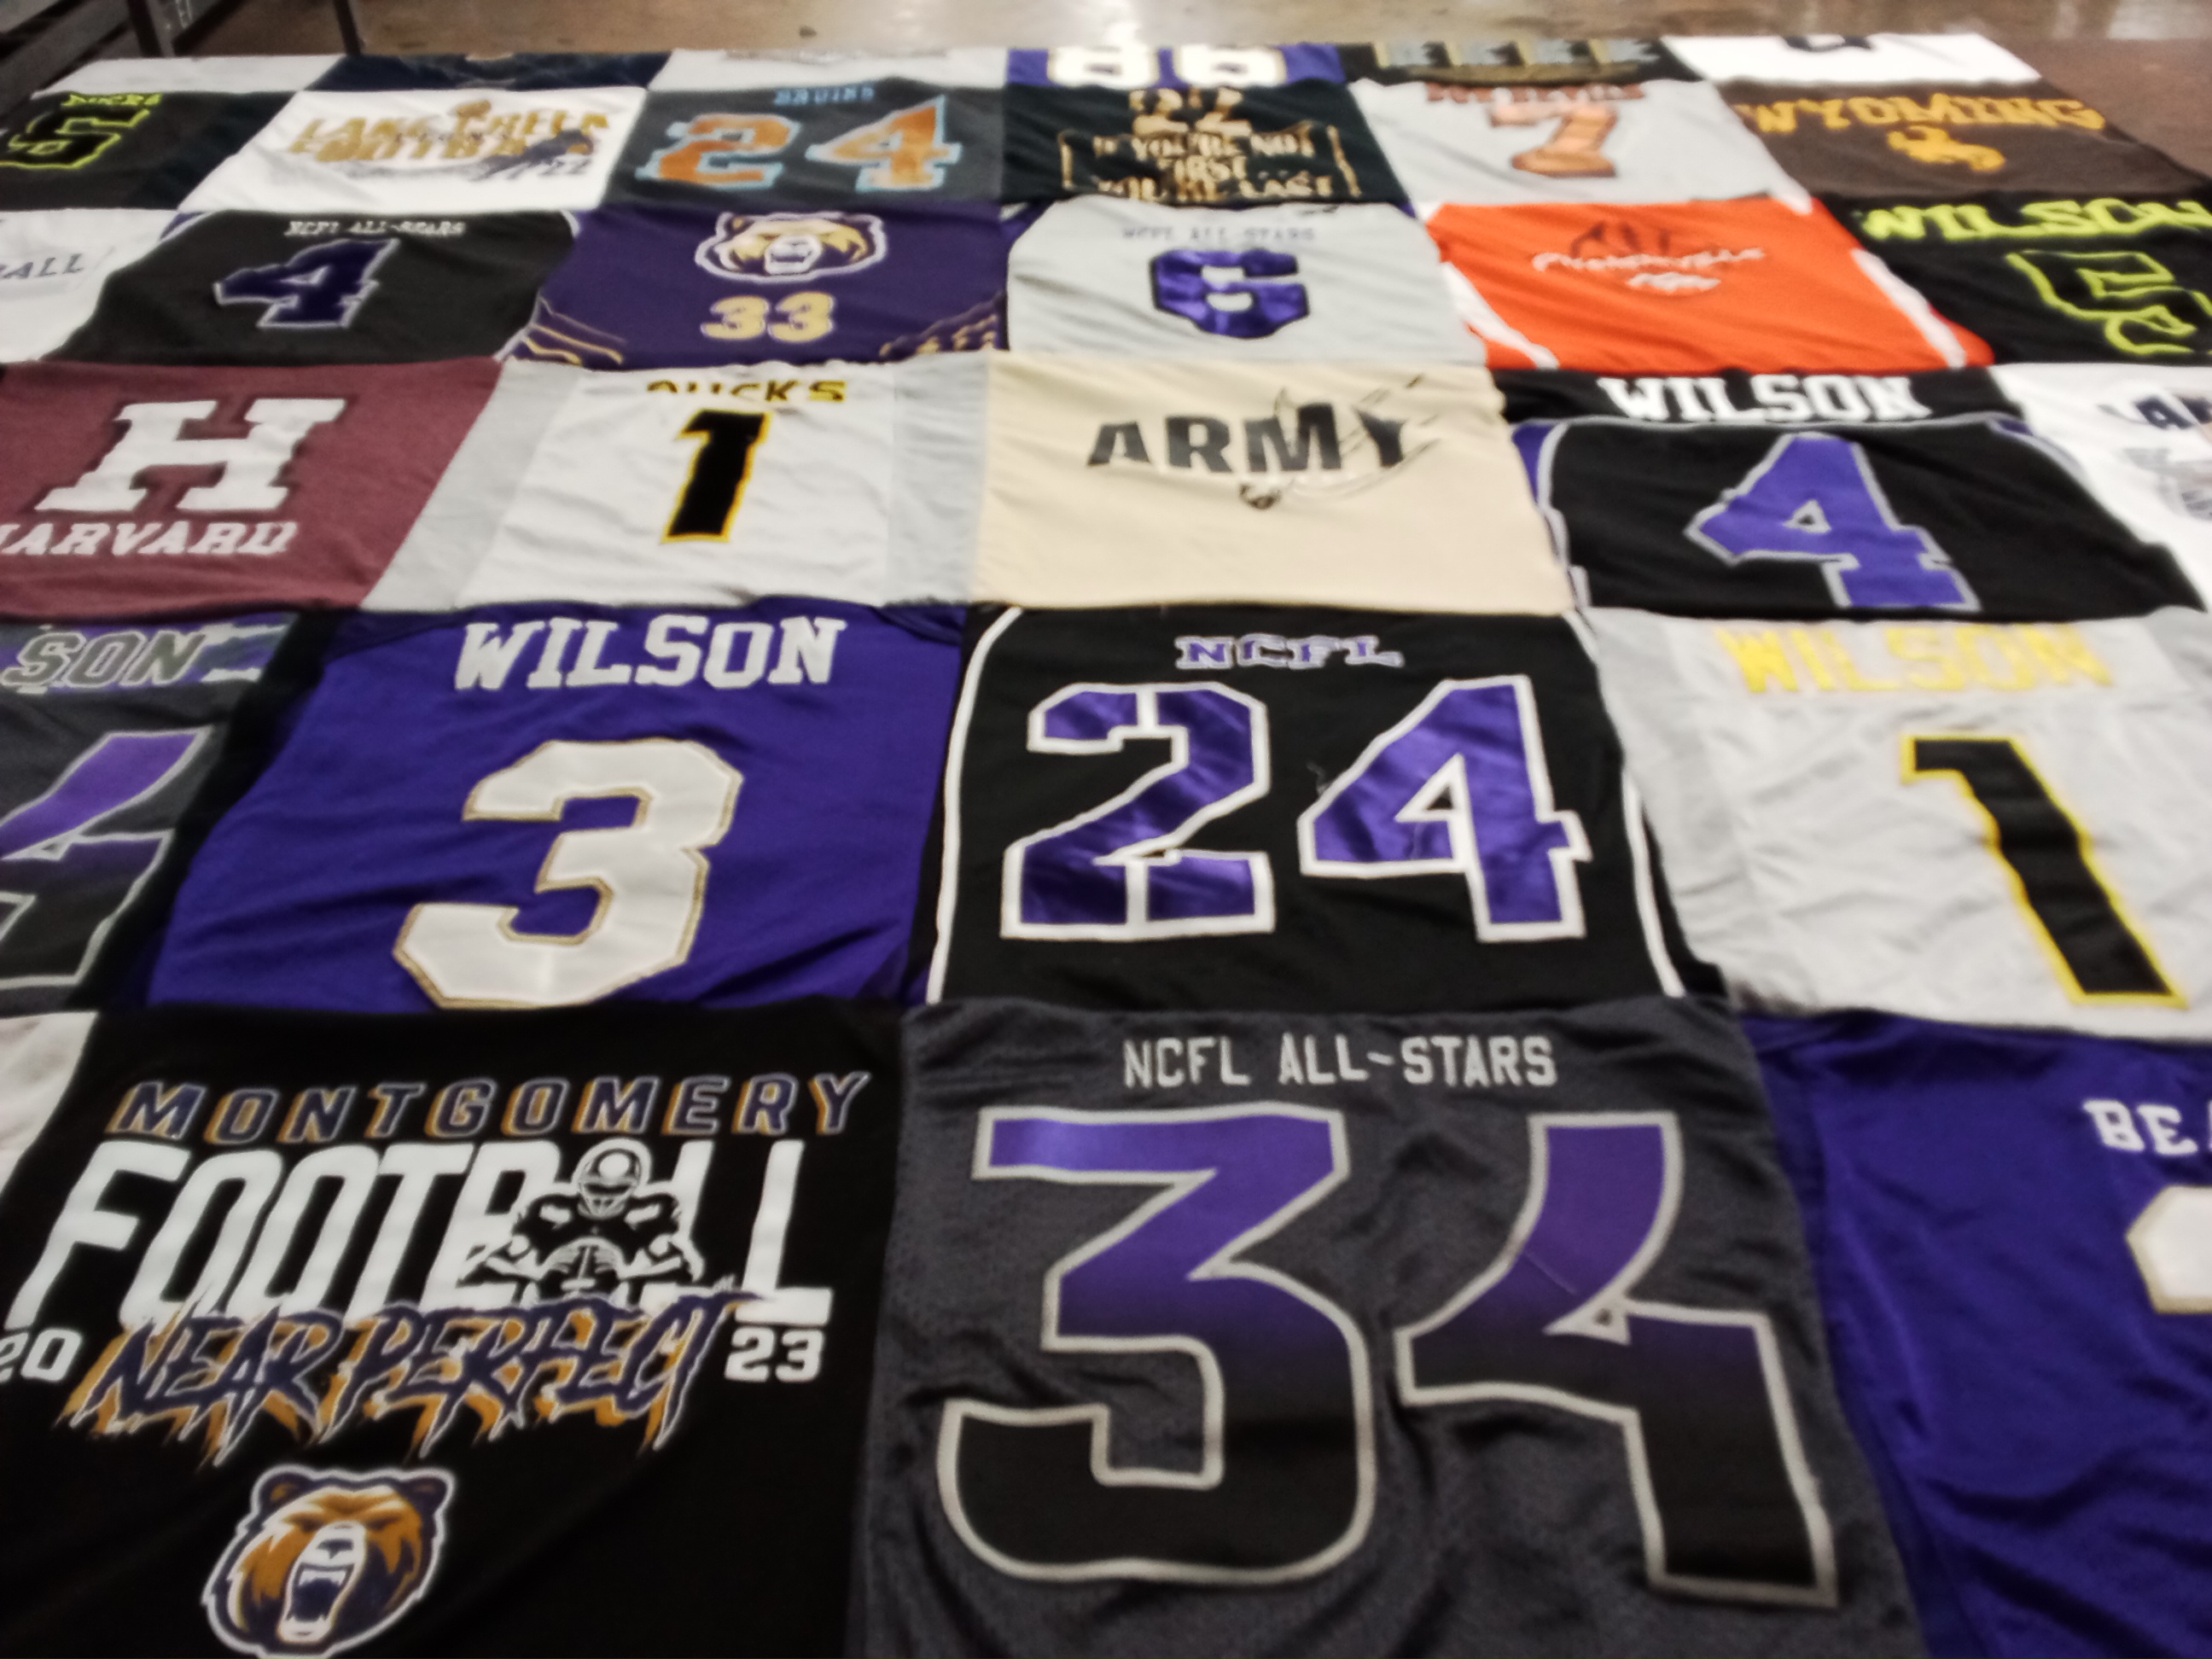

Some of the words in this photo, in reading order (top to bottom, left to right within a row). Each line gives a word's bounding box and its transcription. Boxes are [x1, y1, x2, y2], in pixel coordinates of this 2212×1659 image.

[635, 94, 963, 192] 24
[1731, 91, 2108, 135] WYOMING
[212, 237, 401, 328] 4
[700, 291, 835, 343] 33
[1149, 247, 1311, 341] 6
[1086, 402, 1406, 474] ARMY
[1596, 373, 1932, 422] WILSON
[32, 396, 346, 512] H
[660, 407, 775, 544] 1
[1682, 430, 1982, 613] 4
[453, 614, 848, 691] WILSON
[1174, 632, 1406, 670] NCFL
[1714, 622, 2116, 695] WILSON
[999, 673, 1594, 943] 24
[392, 736, 745, 1010] 3
[1899, 733, 2192, 1011] 1
[1121, 1035, 1252, 1089] NCFL
[1278, 1032, 1558, 1087] ALL-STARS
[103, 1071, 871, 1146] MONTGOMERY
[53, 1293, 329, 1467] NEAR
[317, 1289, 775, 1457] PERFECT
[725, 1327, 826, 1382] 23
[936, 1100, 1837, 1609] 34
